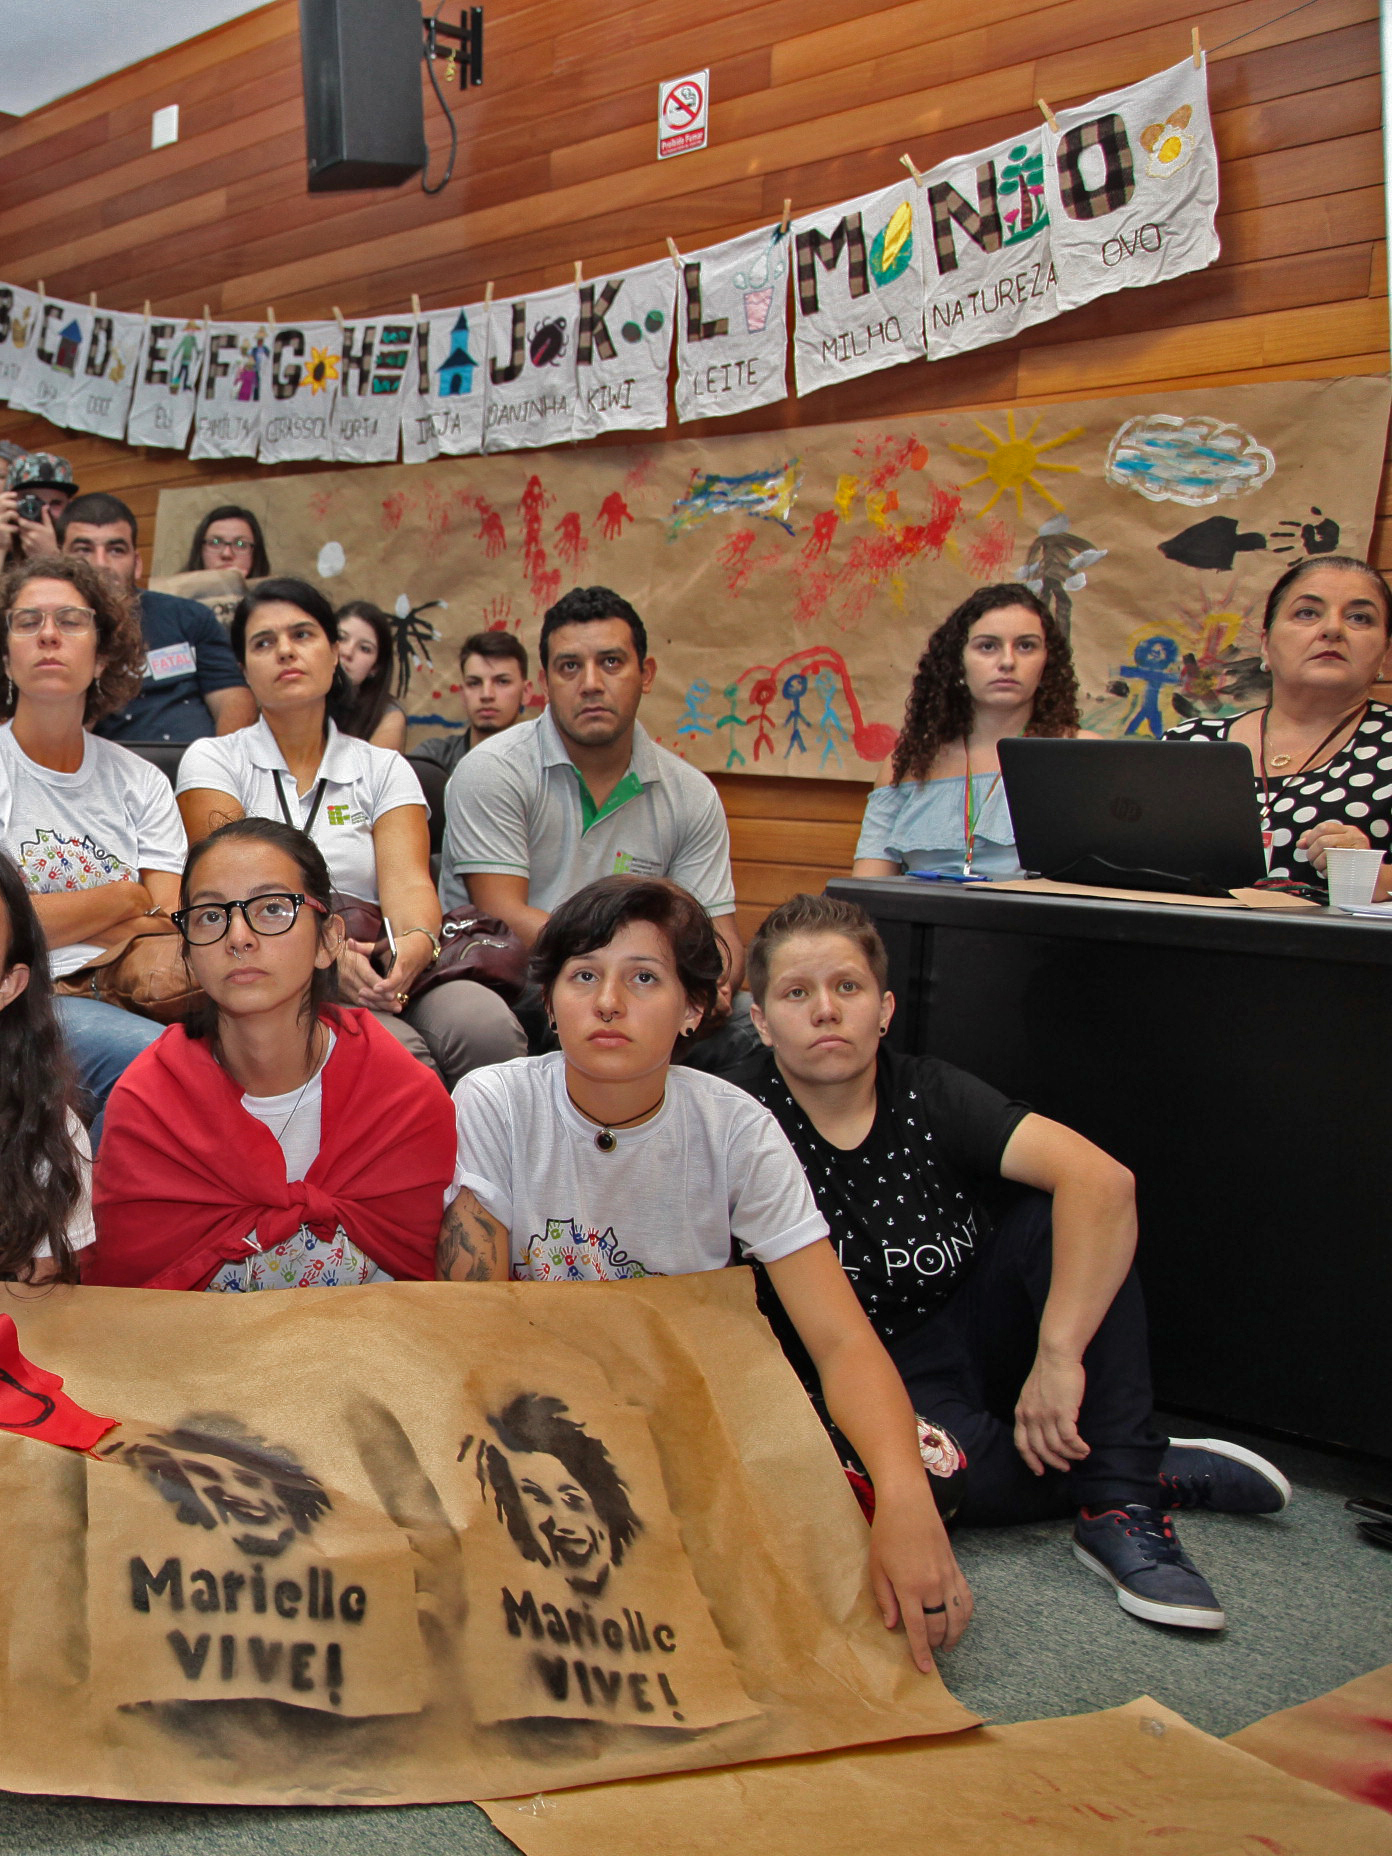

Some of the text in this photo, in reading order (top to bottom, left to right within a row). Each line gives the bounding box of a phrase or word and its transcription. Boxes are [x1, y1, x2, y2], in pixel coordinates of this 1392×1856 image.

[1055, 113, 1135, 221] O
[928, 160, 1004, 276] N
[1101, 222, 1162, 268] OVO
[795, 211, 871, 317] M
[932, 260, 1058, 329] NATUREZA
[37, 303, 64, 365] C
[576, 279, 624, 366] K
[684, 261, 729, 343] L
[85, 317, 113, 377] D
[144, 324, 175, 385] E
[205, 334, 239, 400] F
[271, 329, 305, 400] G
[341, 326, 377, 397] H
[416, 321, 431, 395] I
[490, 301, 527, 385] J
[821, 316, 901, 364] MILHO
[586, 378, 635, 412] KIWI
[693, 358, 759, 397] LEITE
[129, 1555, 368, 1623] Marielle
[501, 1586, 677, 1653] Marielle
[166, 1628, 344, 1707] VIVE!
[532, 1650, 686, 1722] VIVE!
